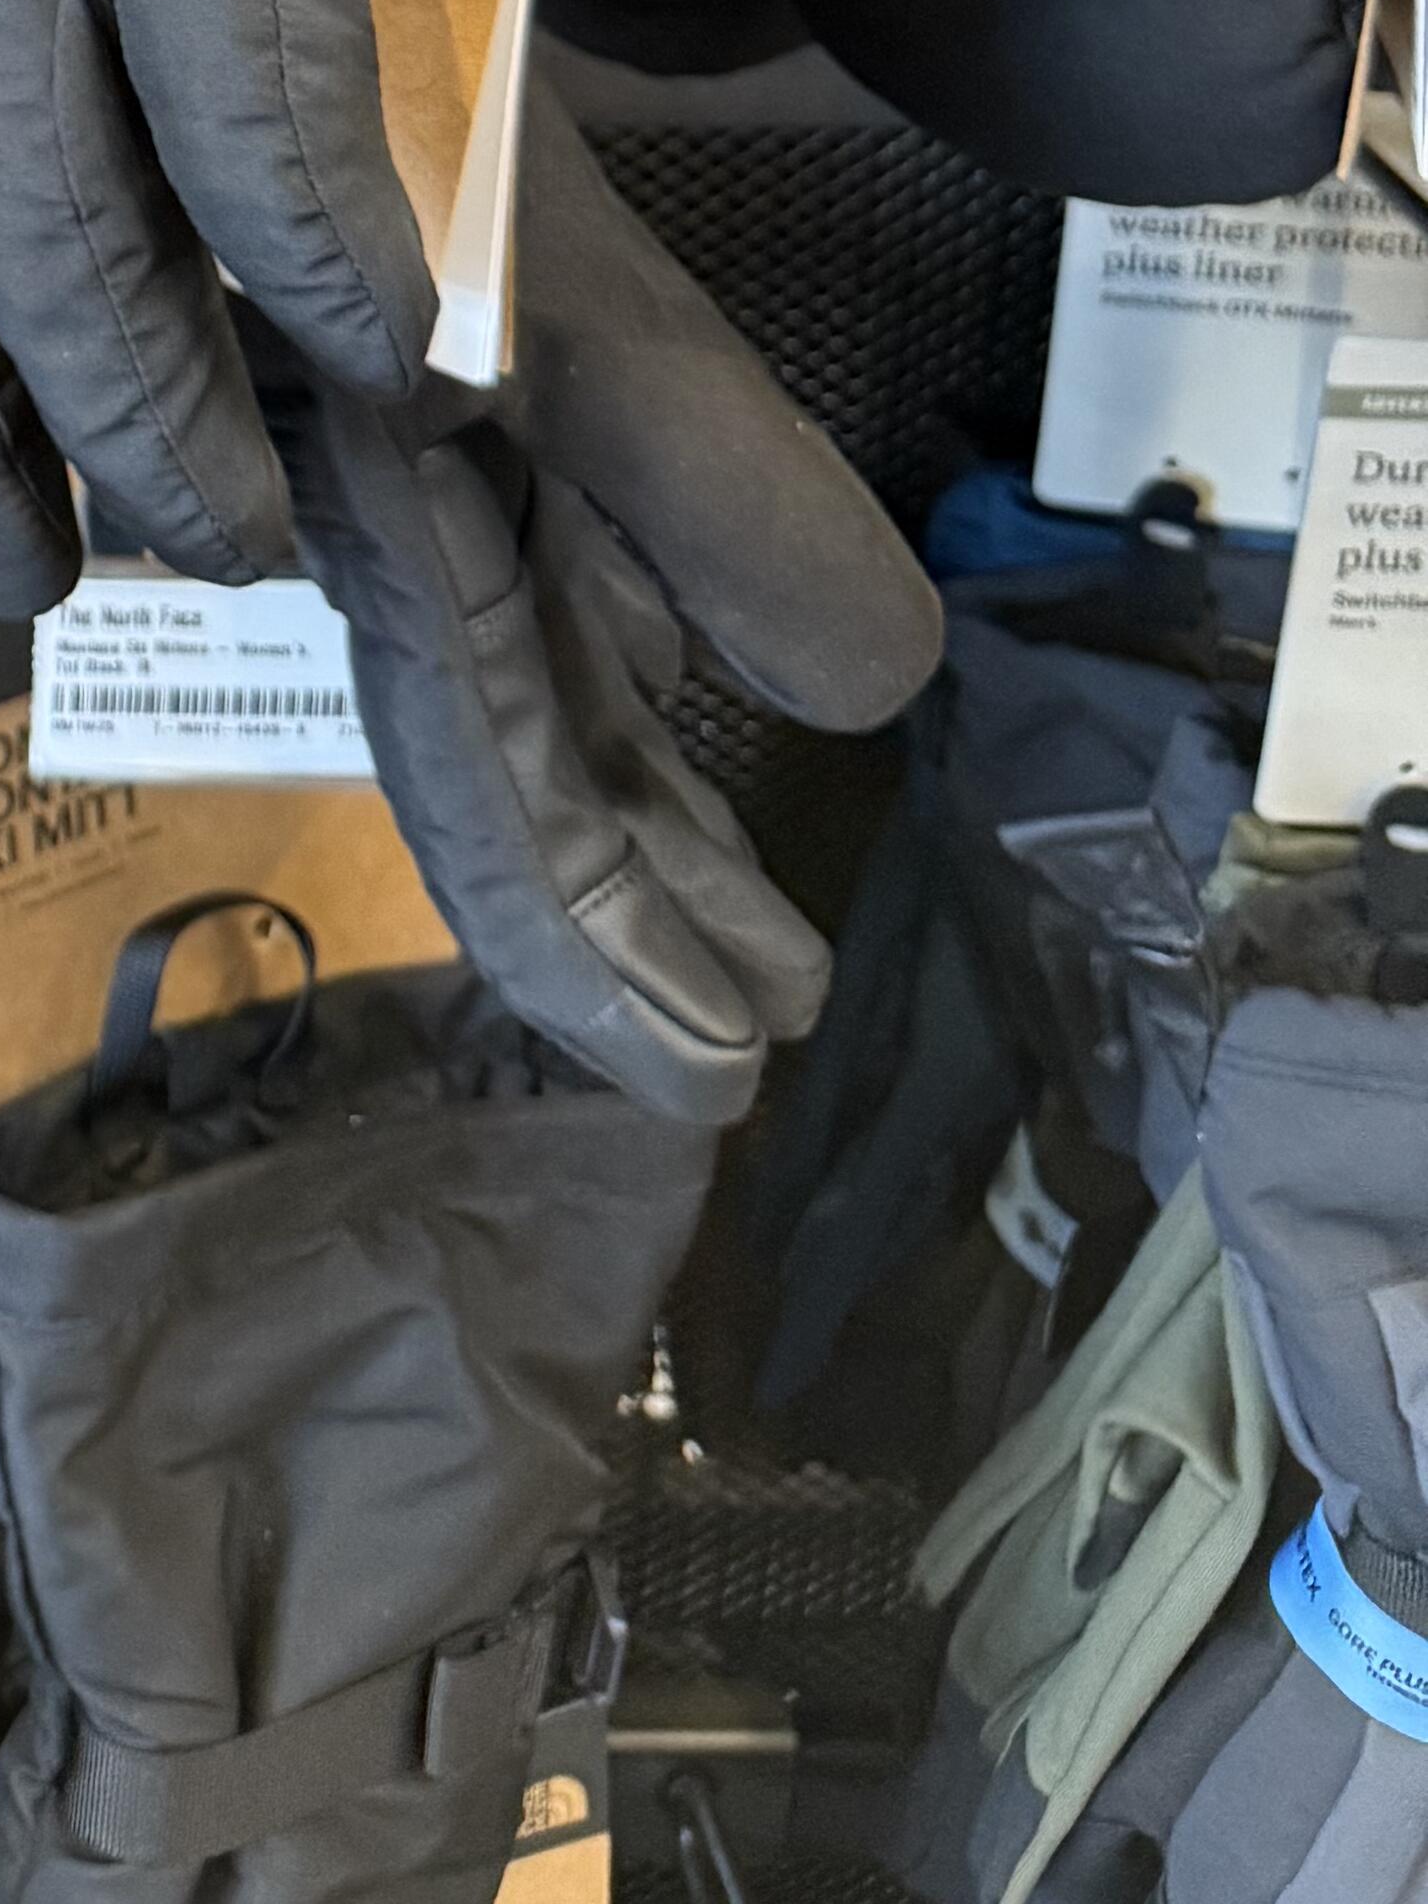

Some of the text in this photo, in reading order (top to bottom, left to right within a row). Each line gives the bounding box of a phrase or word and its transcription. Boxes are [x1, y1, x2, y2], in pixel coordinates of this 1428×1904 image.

[1109, 209, 1267, 243] weather
[1100, 242, 1286, 286] plus liner
[1336, 537, 1425, 579] plus
